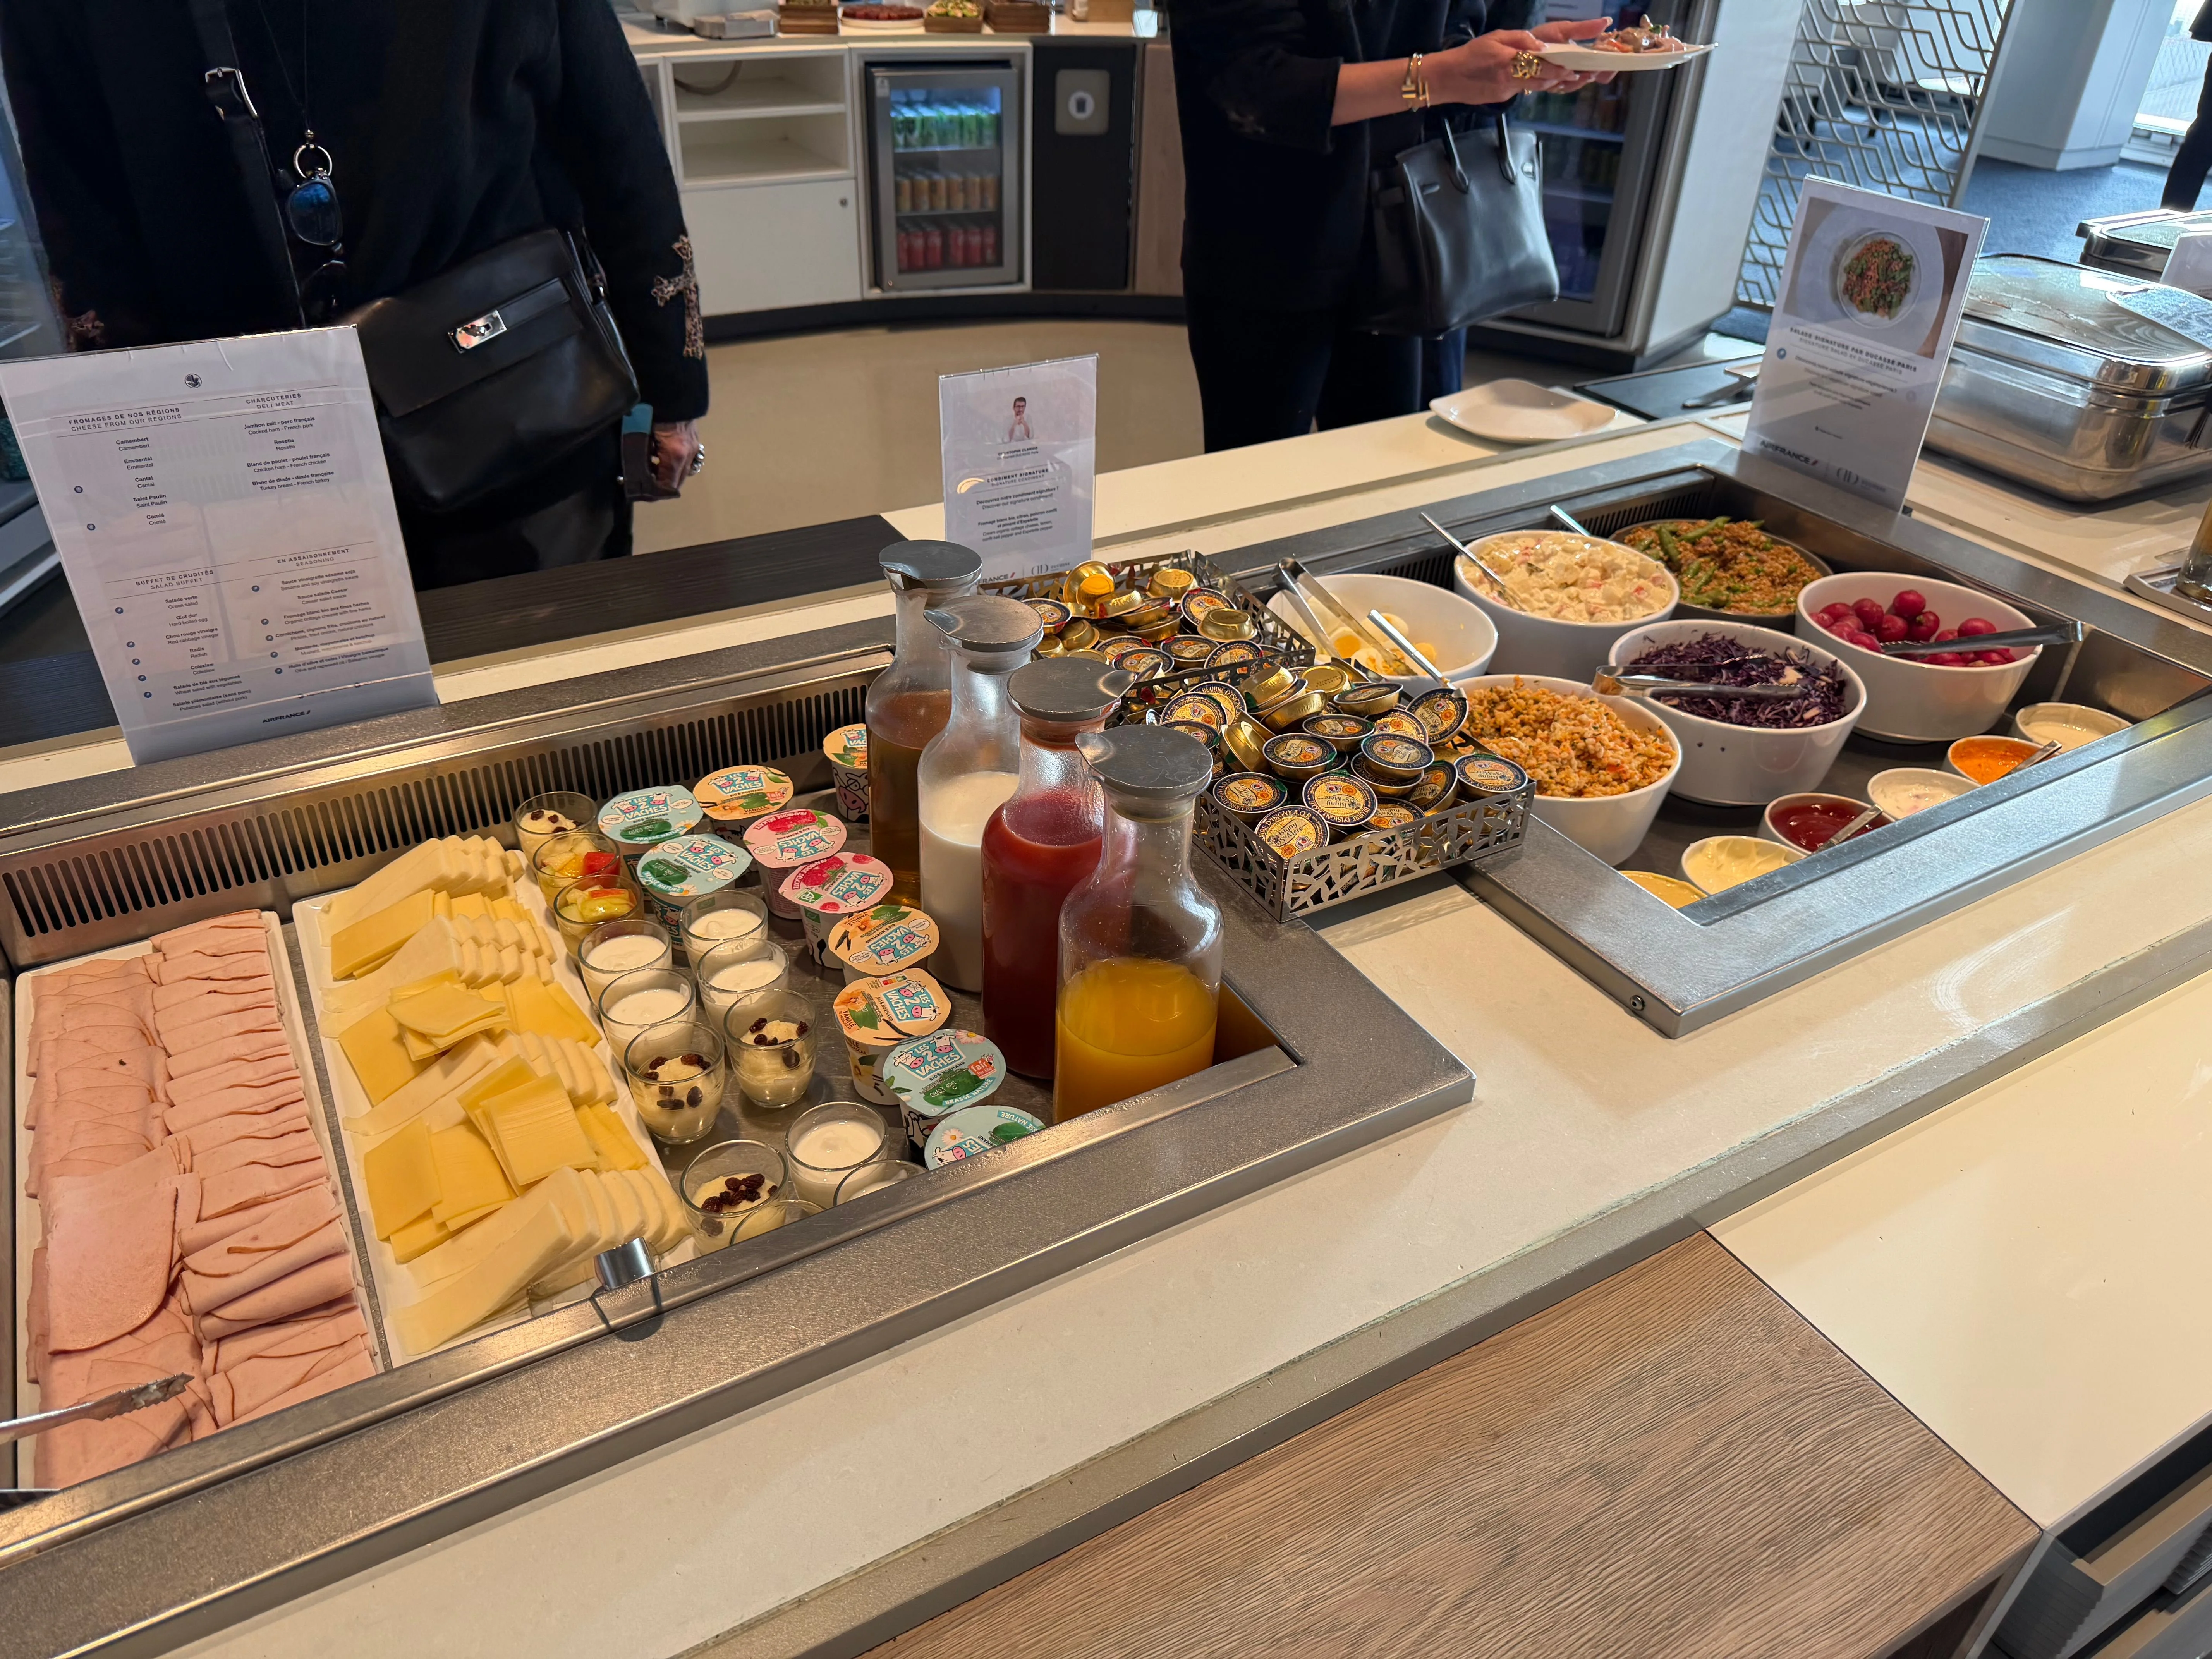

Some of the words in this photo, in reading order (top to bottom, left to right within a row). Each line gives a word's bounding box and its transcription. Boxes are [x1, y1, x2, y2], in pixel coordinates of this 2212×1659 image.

[246, 393, 301, 404] CHARCUTERIES
[69, 416, 112, 424] FROMAGES
[71, 423, 102, 431] CHEESE
[149, 414, 181, 422] REGIONS
[289, 548, 349, 562] ASSAISONNEMENT
[296, 557, 335, 567] SEASONING
[263, 710, 305, 723] AIRFRANCE
[723, 781, 762, 793] VACHES
[626, 805, 668, 819] VACHES
[1278, 822, 1297, 836] Isigny
[779, 831, 819, 847] VACHES
[680, 850, 714, 870] VACHES
[699, 850, 714, 859] 2
[832, 872, 862, 896] VACHES
[862, 886, 874, 895] LES
[847, 914, 869, 927] VANILLE
[871, 927, 909, 950] VACHES
[891, 939, 904, 949] 2
[900, 946, 913, 956] LES
[919, 994, 930, 1003] LES
[886, 991, 910, 1020] VACHES
[843, 1010, 856, 1027] VANILLE
[914, 1044, 930, 1054] LES
[924, 1051, 938, 1061] 2
[916, 1052, 960, 1075] VACHES
[942, 1061, 965, 1075] NORMAND
[971, 1060, 987, 1072] fair
[972, 1079, 993, 1096] NATURE
[1001, 1111, 1028, 1125] NATURE
